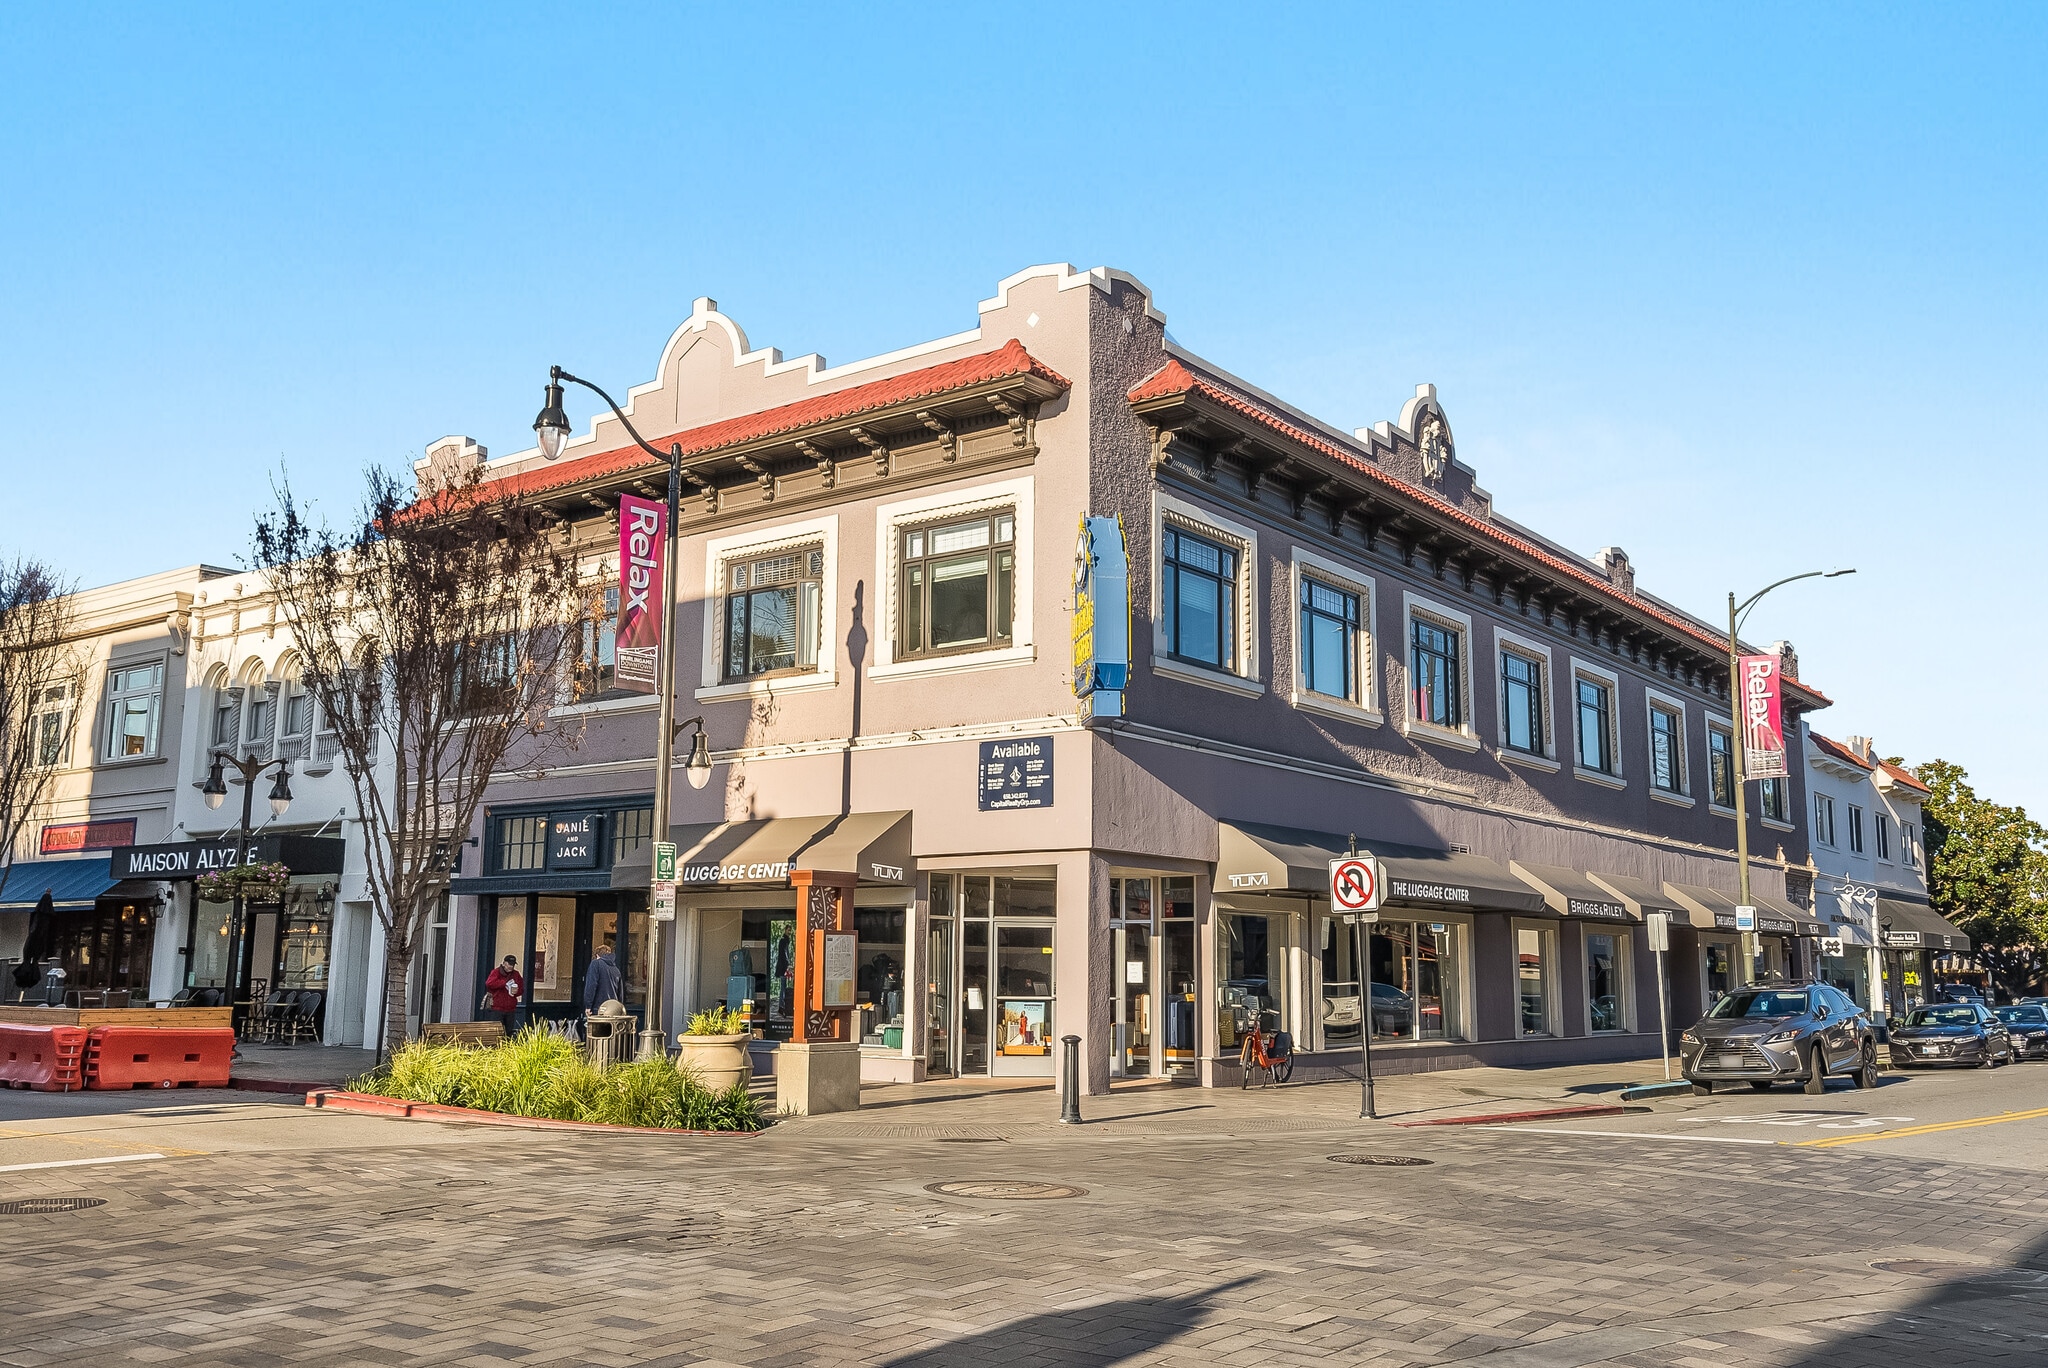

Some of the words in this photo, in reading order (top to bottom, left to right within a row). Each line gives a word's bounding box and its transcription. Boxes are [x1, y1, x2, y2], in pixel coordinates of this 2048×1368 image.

[626, 505, 658, 614] Relax
[620, 655, 653, 665] BURLINGAME
[620, 661, 653, 671] DOWNTOWN
[1747, 660, 1773, 729] Relax
[991, 741, 1041, 759] Available
[990, 799, 1041, 809] CapitalRealtyGrp.com
[555, 822, 590, 834] JANIE
[129, 851, 190, 873] MAISON
[195, 846, 258, 869] ALYZE
[556, 846, 587, 858] JACK
[684, 864, 744, 882] LUGGAGE
[871, 863, 904, 880] TUMI
[1228, 872, 1269, 888] TUMI
[1393, 882, 1407, 896] THE
[1408, 884, 1443, 900] LUGGAGE
[1444, 887, 1469, 902] CENTER
[1570, 900, 1599, 915] BRIGGS
[1599, 906, 1604, 916] &
[1603, 903, 1623, 917] RILEY
[1716, 915, 1724, 925] THE
[1759, 918, 1777, 930] BRIGGS
[1780, 921, 1792, 931] RILEY
